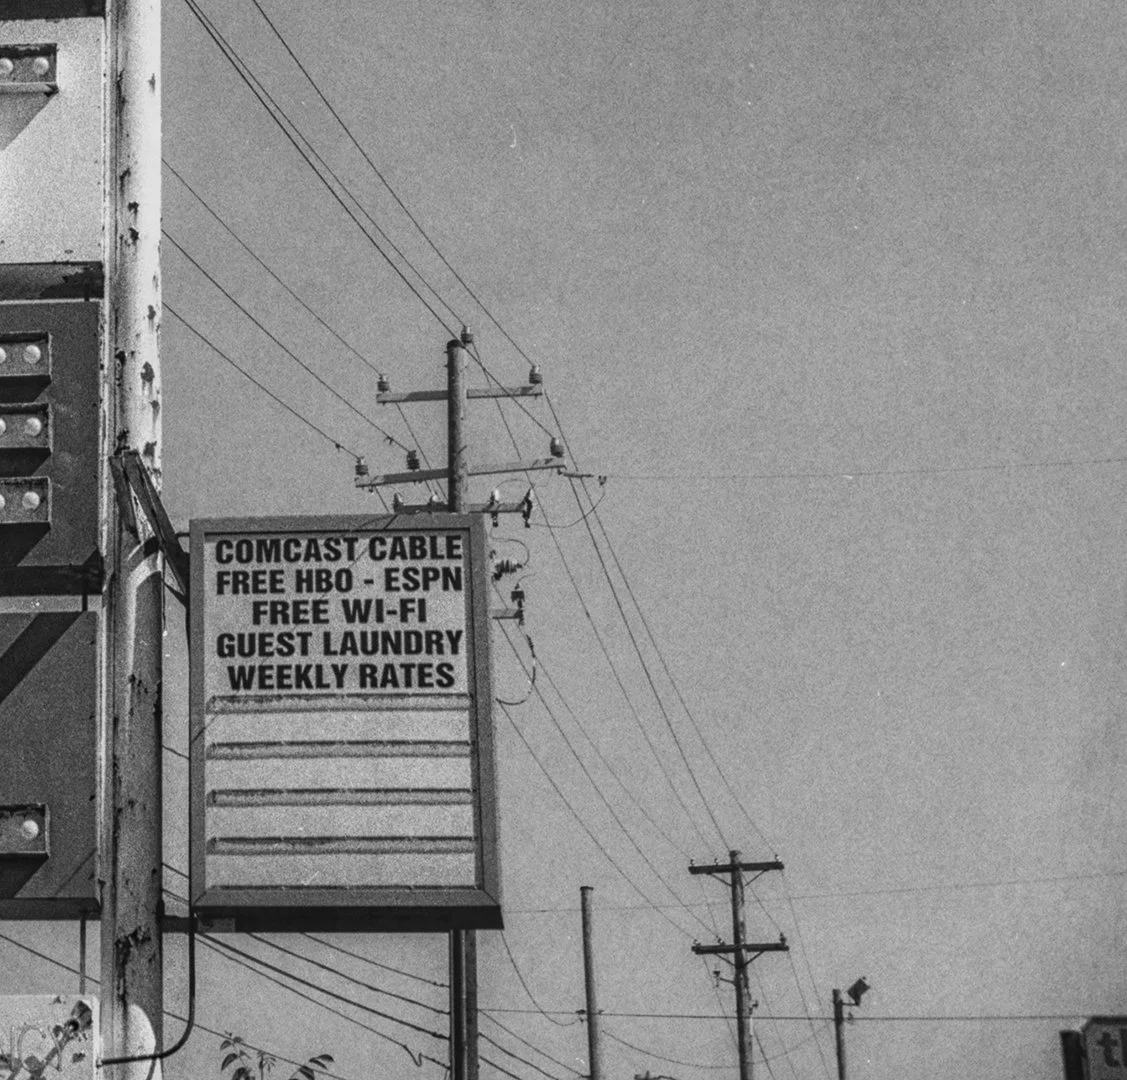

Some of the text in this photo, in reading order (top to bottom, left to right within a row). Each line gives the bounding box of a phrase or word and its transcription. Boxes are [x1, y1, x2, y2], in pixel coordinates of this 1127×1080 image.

[215, 534, 463, 565] COMCAST CABLE
[216, 569, 286, 595] FREE
[295, 568, 354, 594] HBO
[384, 566, 463, 592] ESPN
[252, 598, 427, 626] FREE WI-FI
[216, 630, 464, 659] GUEST LAUNDRY
[227, 662, 455, 690] WEEKLY RATES
